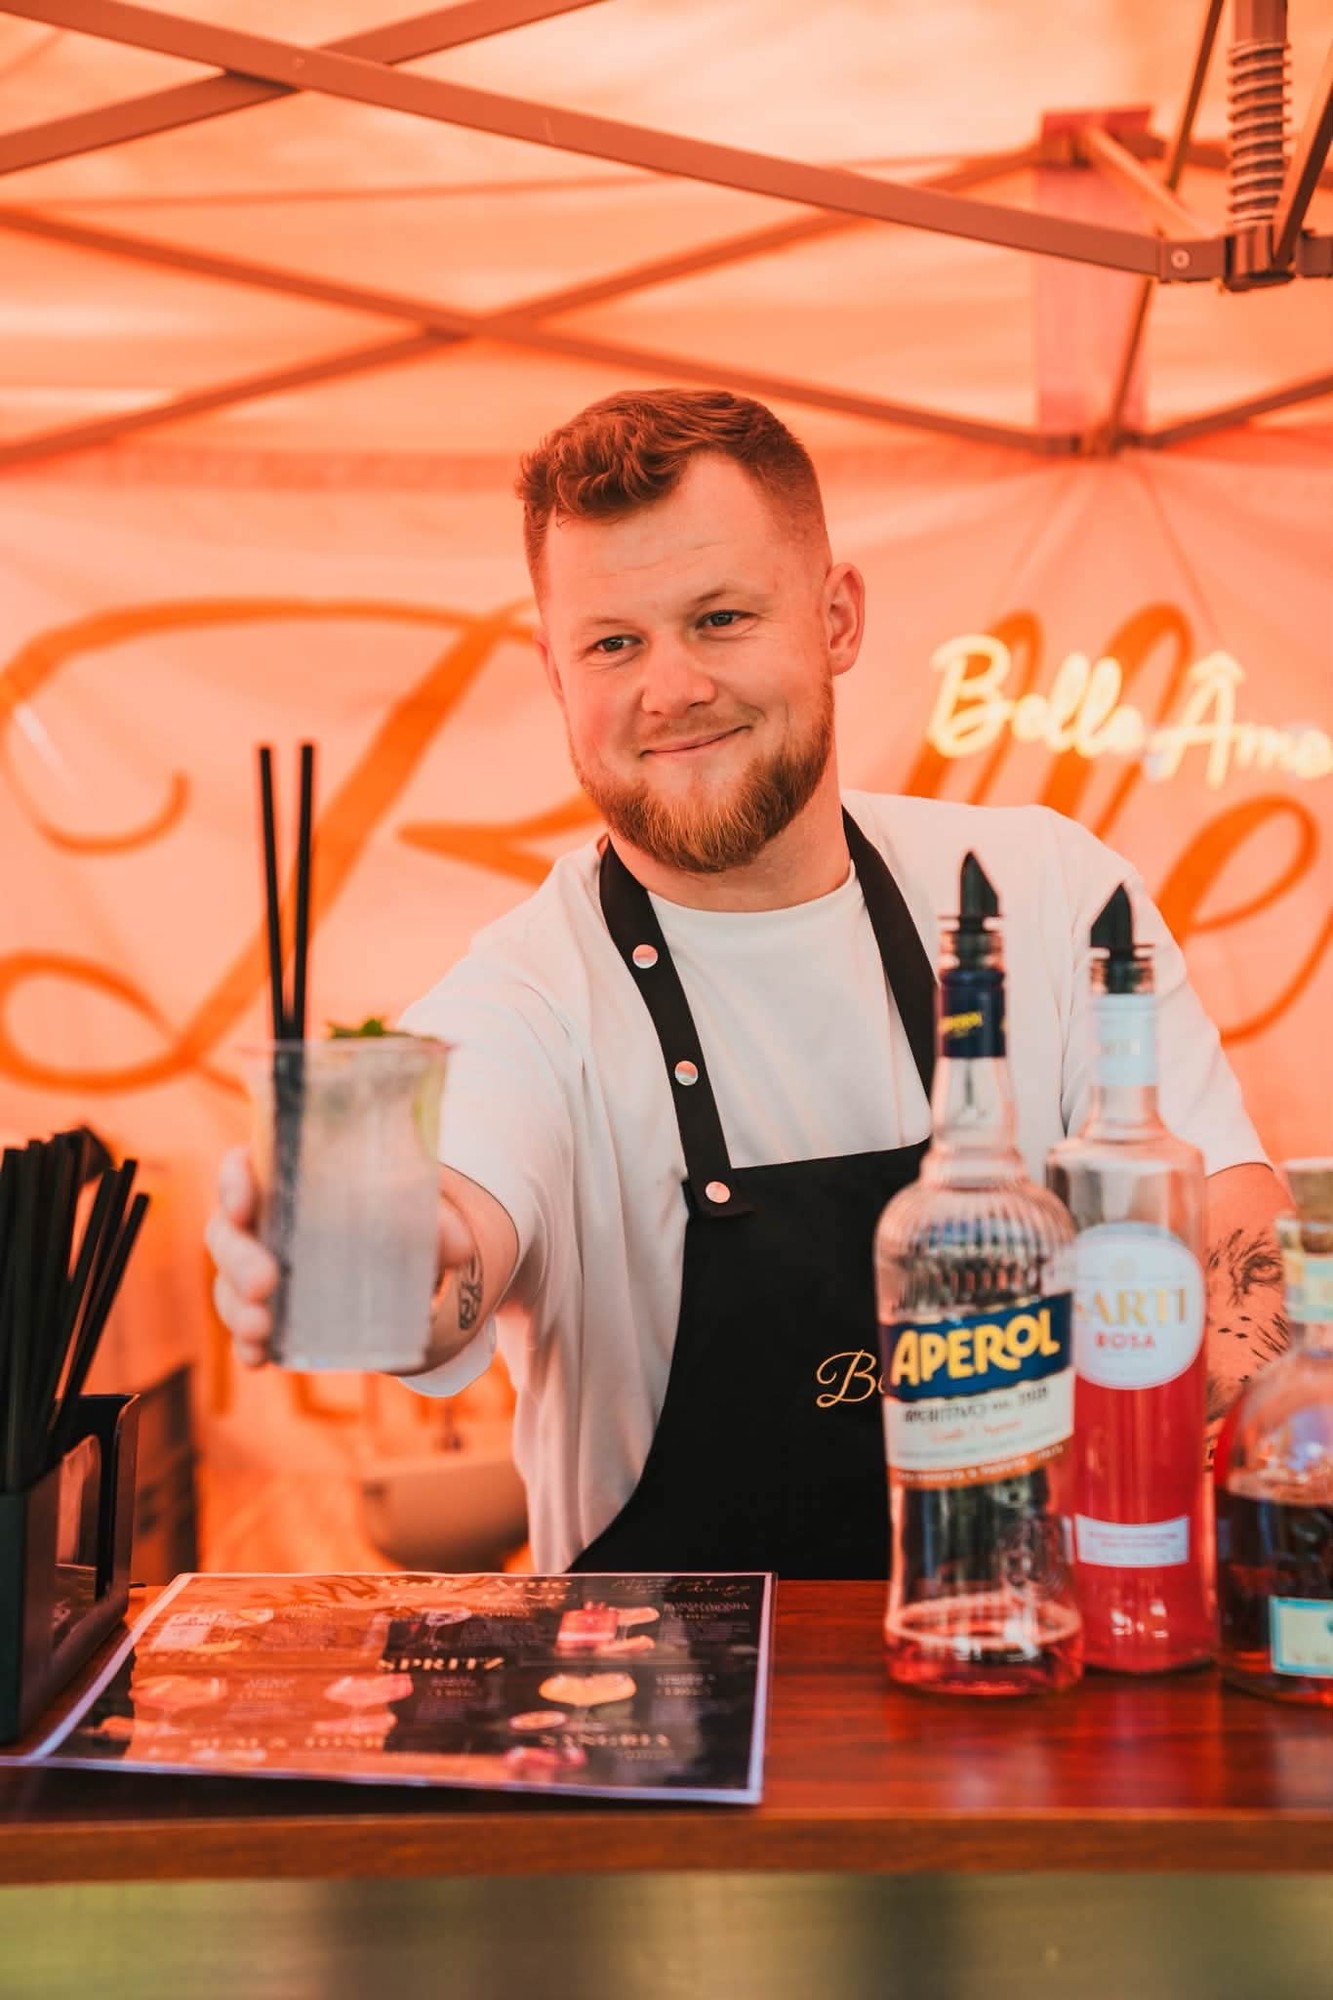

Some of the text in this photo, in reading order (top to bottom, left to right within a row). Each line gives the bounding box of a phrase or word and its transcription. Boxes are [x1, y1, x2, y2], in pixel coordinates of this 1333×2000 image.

[890, 1308, 1061, 1387] APEROL
[1095, 1332, 1155, 1349] ROSA
[816, 1349, 885, 1408] B
